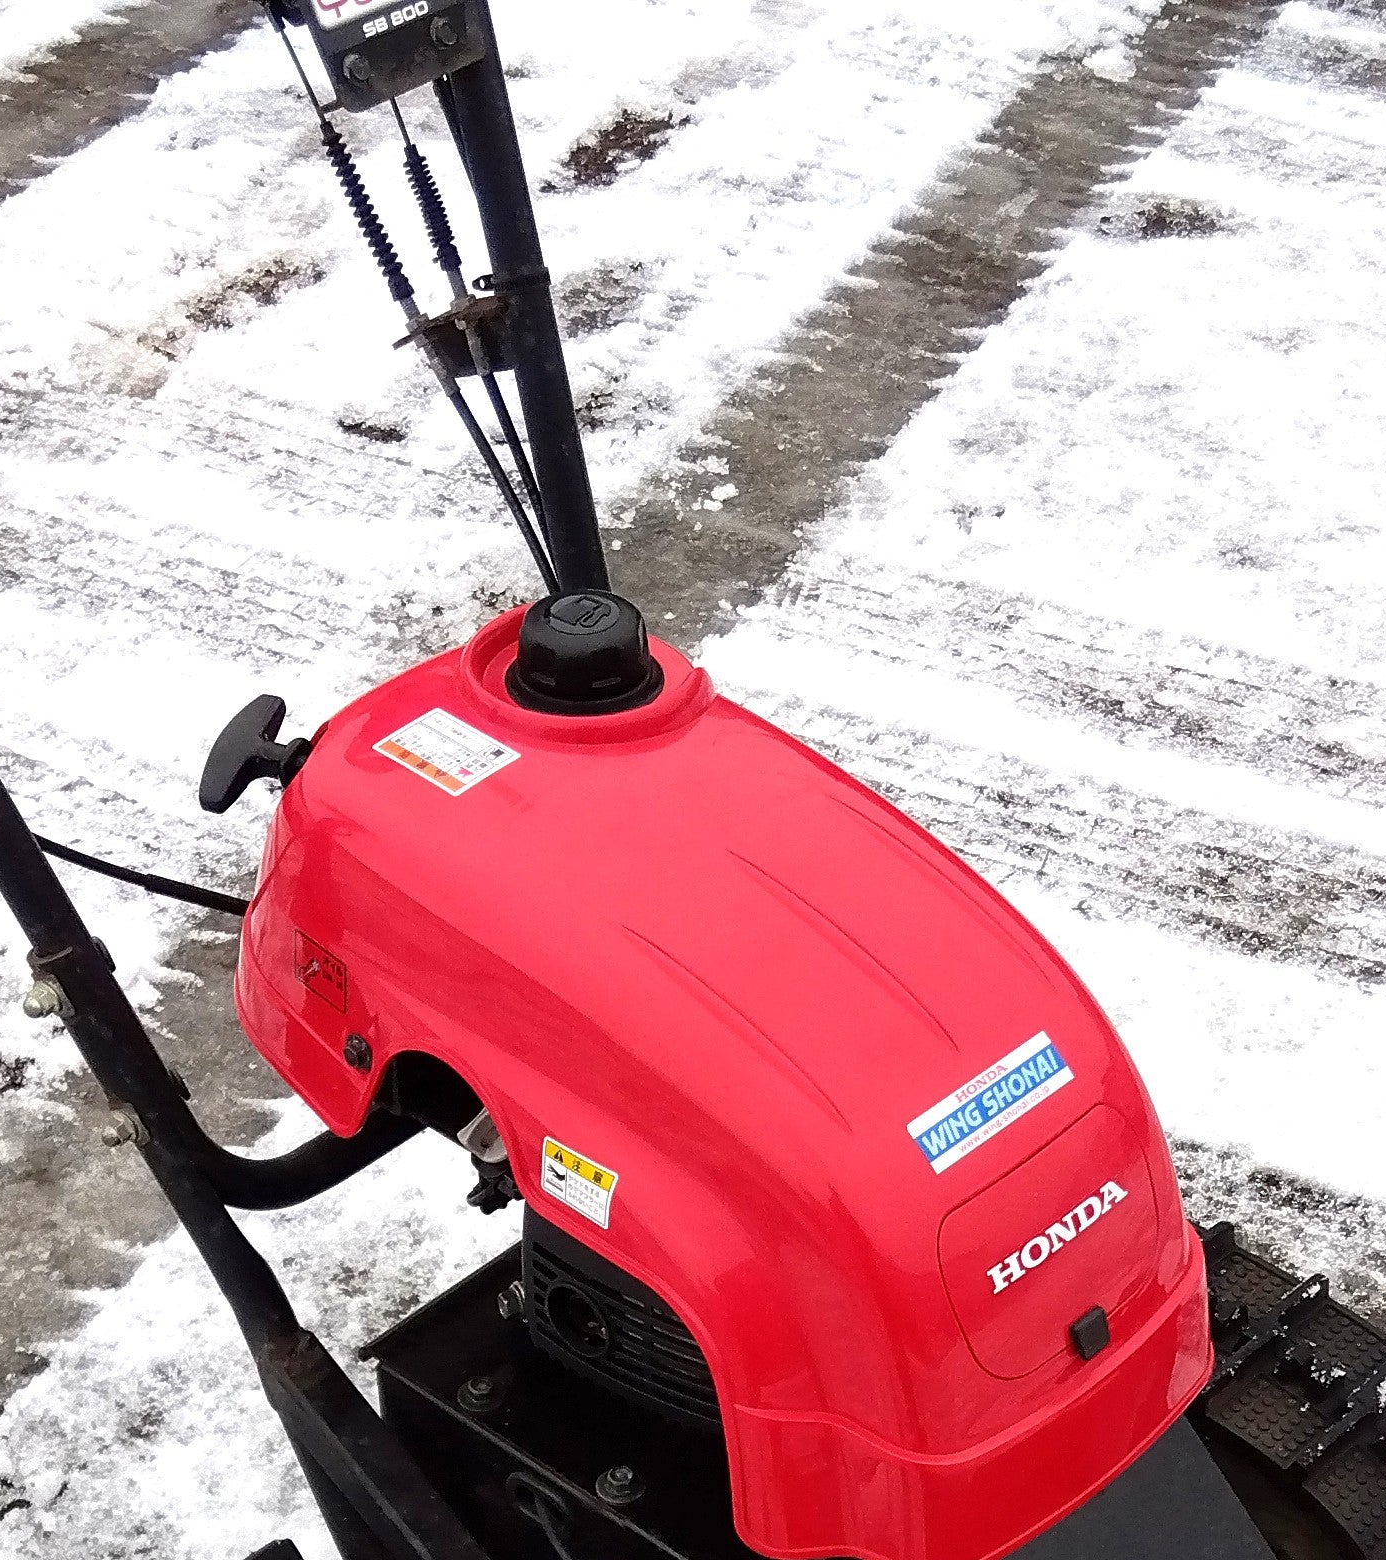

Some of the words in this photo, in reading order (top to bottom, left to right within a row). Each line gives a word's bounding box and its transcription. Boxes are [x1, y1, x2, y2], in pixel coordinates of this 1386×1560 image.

[363, 17, 388, 38] SB
[390, 1, 429, 26] 800
[921, 1101, 982, 1156] WING
[981, 1048, 1059, 1117] SHONAI
[954, 1065, 1008, 1103] HONDA
[571, 1158, 603, 1184] 注意
[986, 1181, 1128, 1295] HONDA
